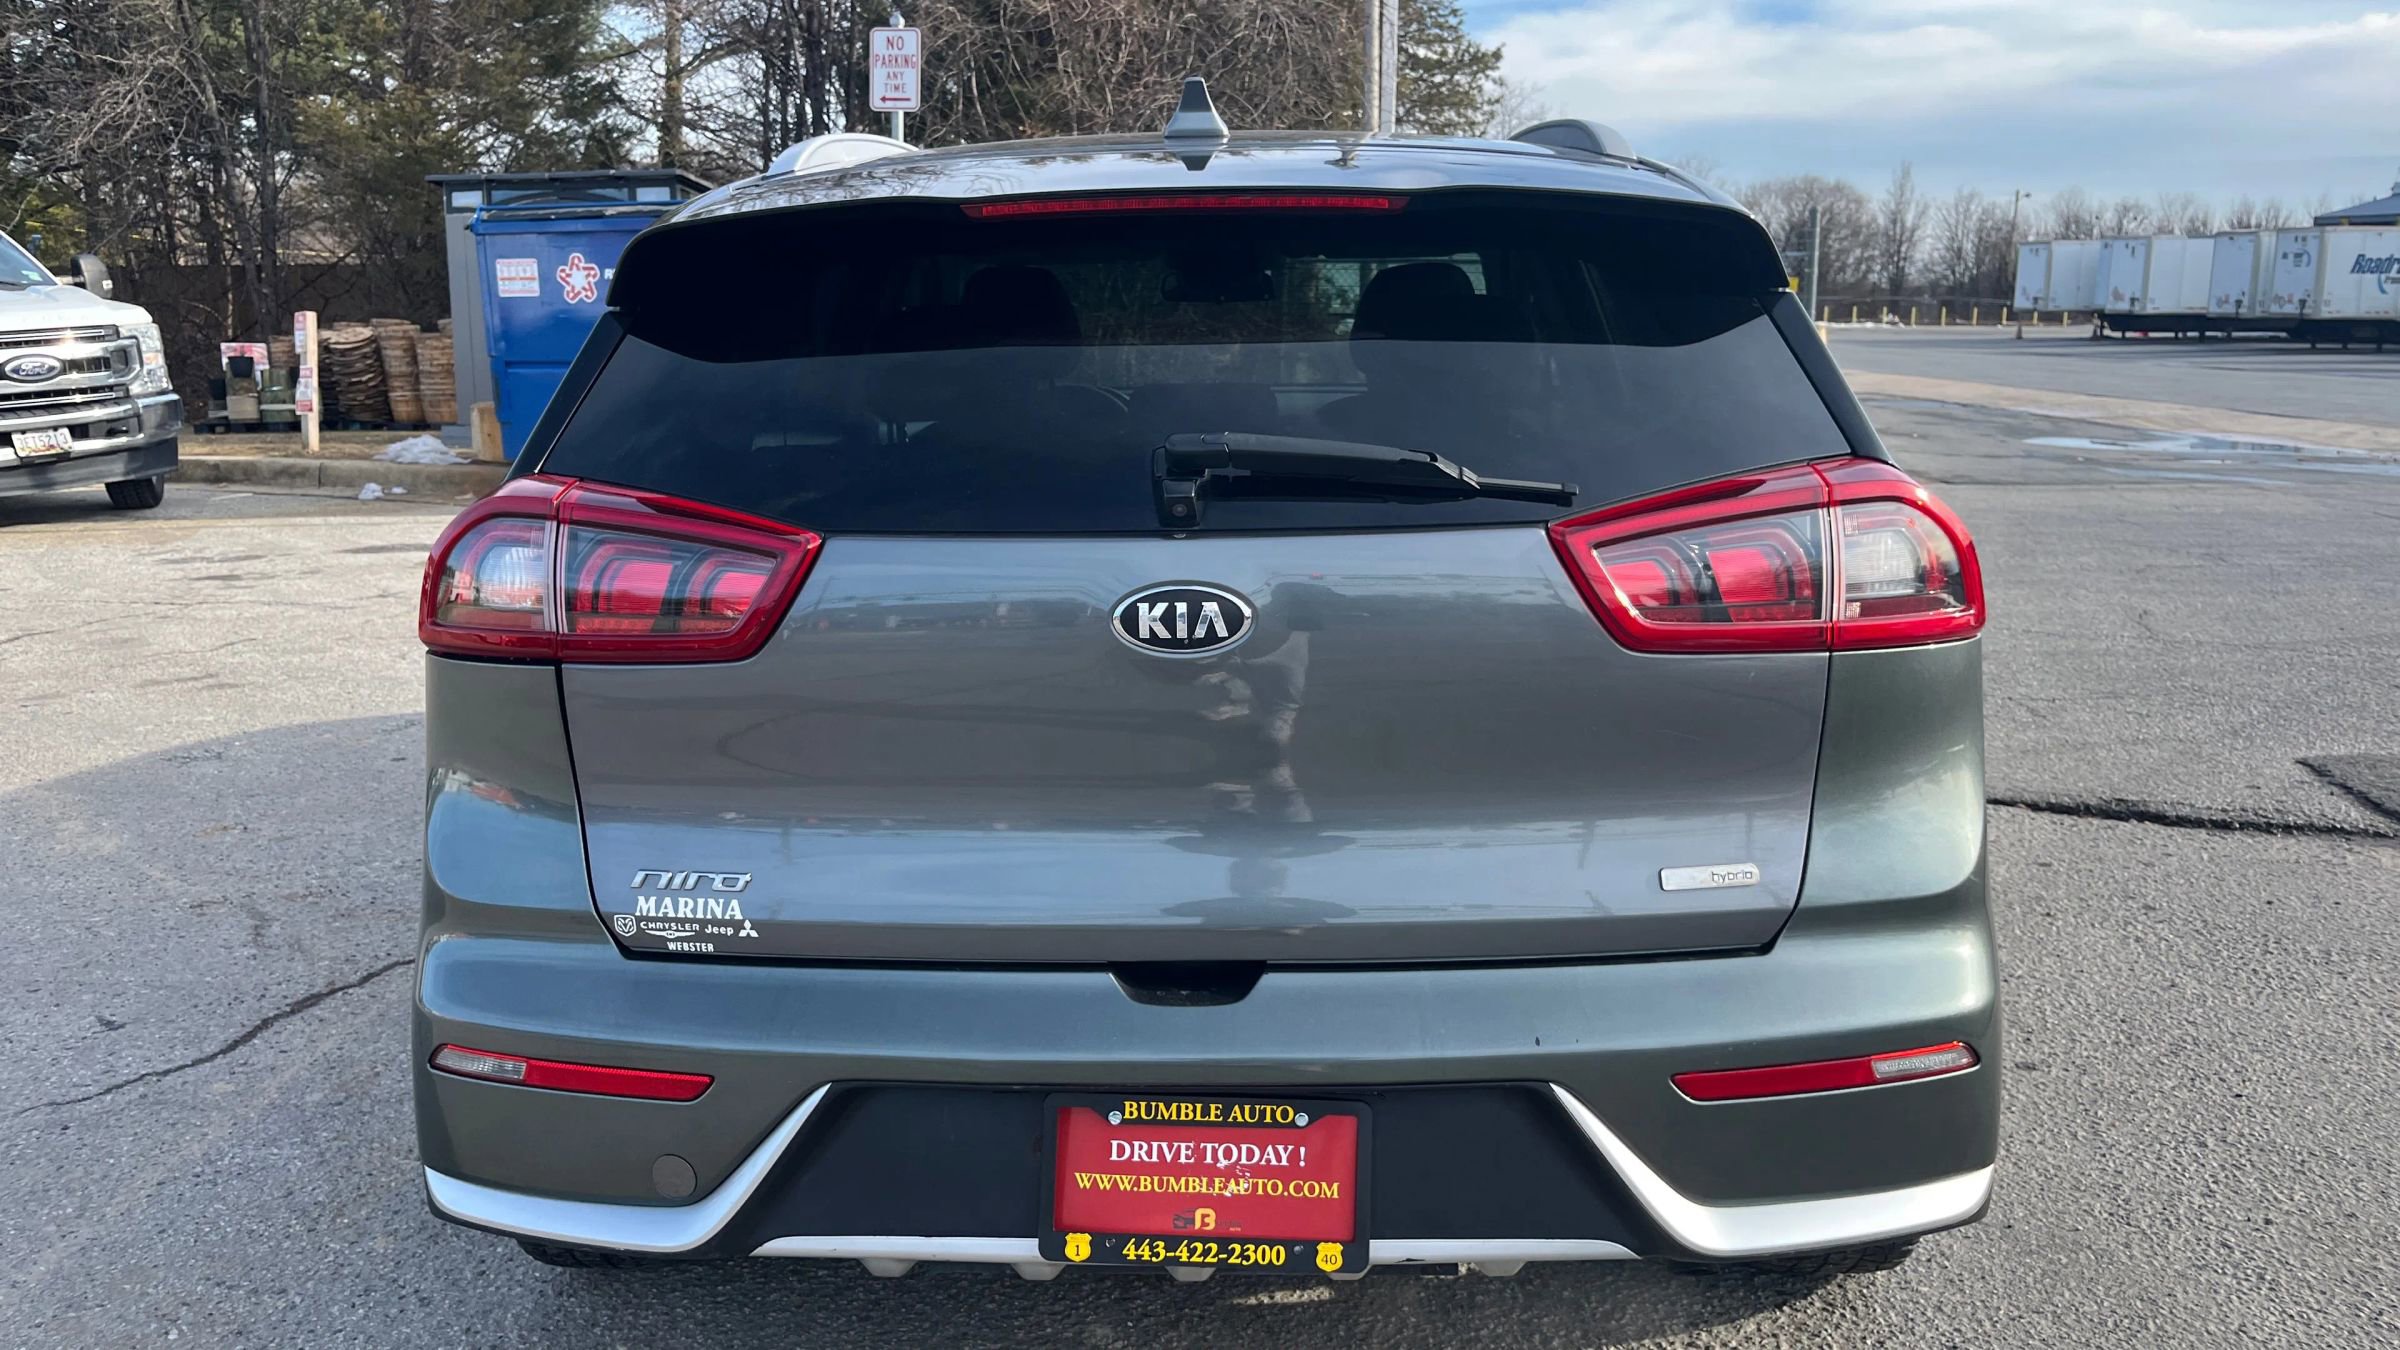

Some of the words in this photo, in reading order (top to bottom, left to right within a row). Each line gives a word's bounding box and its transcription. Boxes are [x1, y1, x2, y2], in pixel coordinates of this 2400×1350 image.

[885, 35, 905, 51] NO
[874, 54, 917, 69] PARKING
[885, 71, 905, 82] ANY
[884, 82, 907, 94] TIME
[20, 362, 49, 376] Ford
[1136, 602, 1229, 639] KIA
[1711, 870, 1753, 884] hybrid
[635, 895, 744, 920] MARINA
[640, 921, 700, 931] CHRYSLER
[705, 924, 734, 936] Jeep
[667, 941, 714, 953] WEBSTER
[1122, 1101, 1223, 1122] BUMBLE
[1227, 1104, 1295, 1124] AUTO
[1109, 1140, 1195, 1164] DRIVE
[1074, 1172, 1340, 1198] WWW.BUMBLEAUTO.COM
[1121, 1237, 1287, 1266] 443-422-2300
[1321, 1253, 1338, 1266] 40
